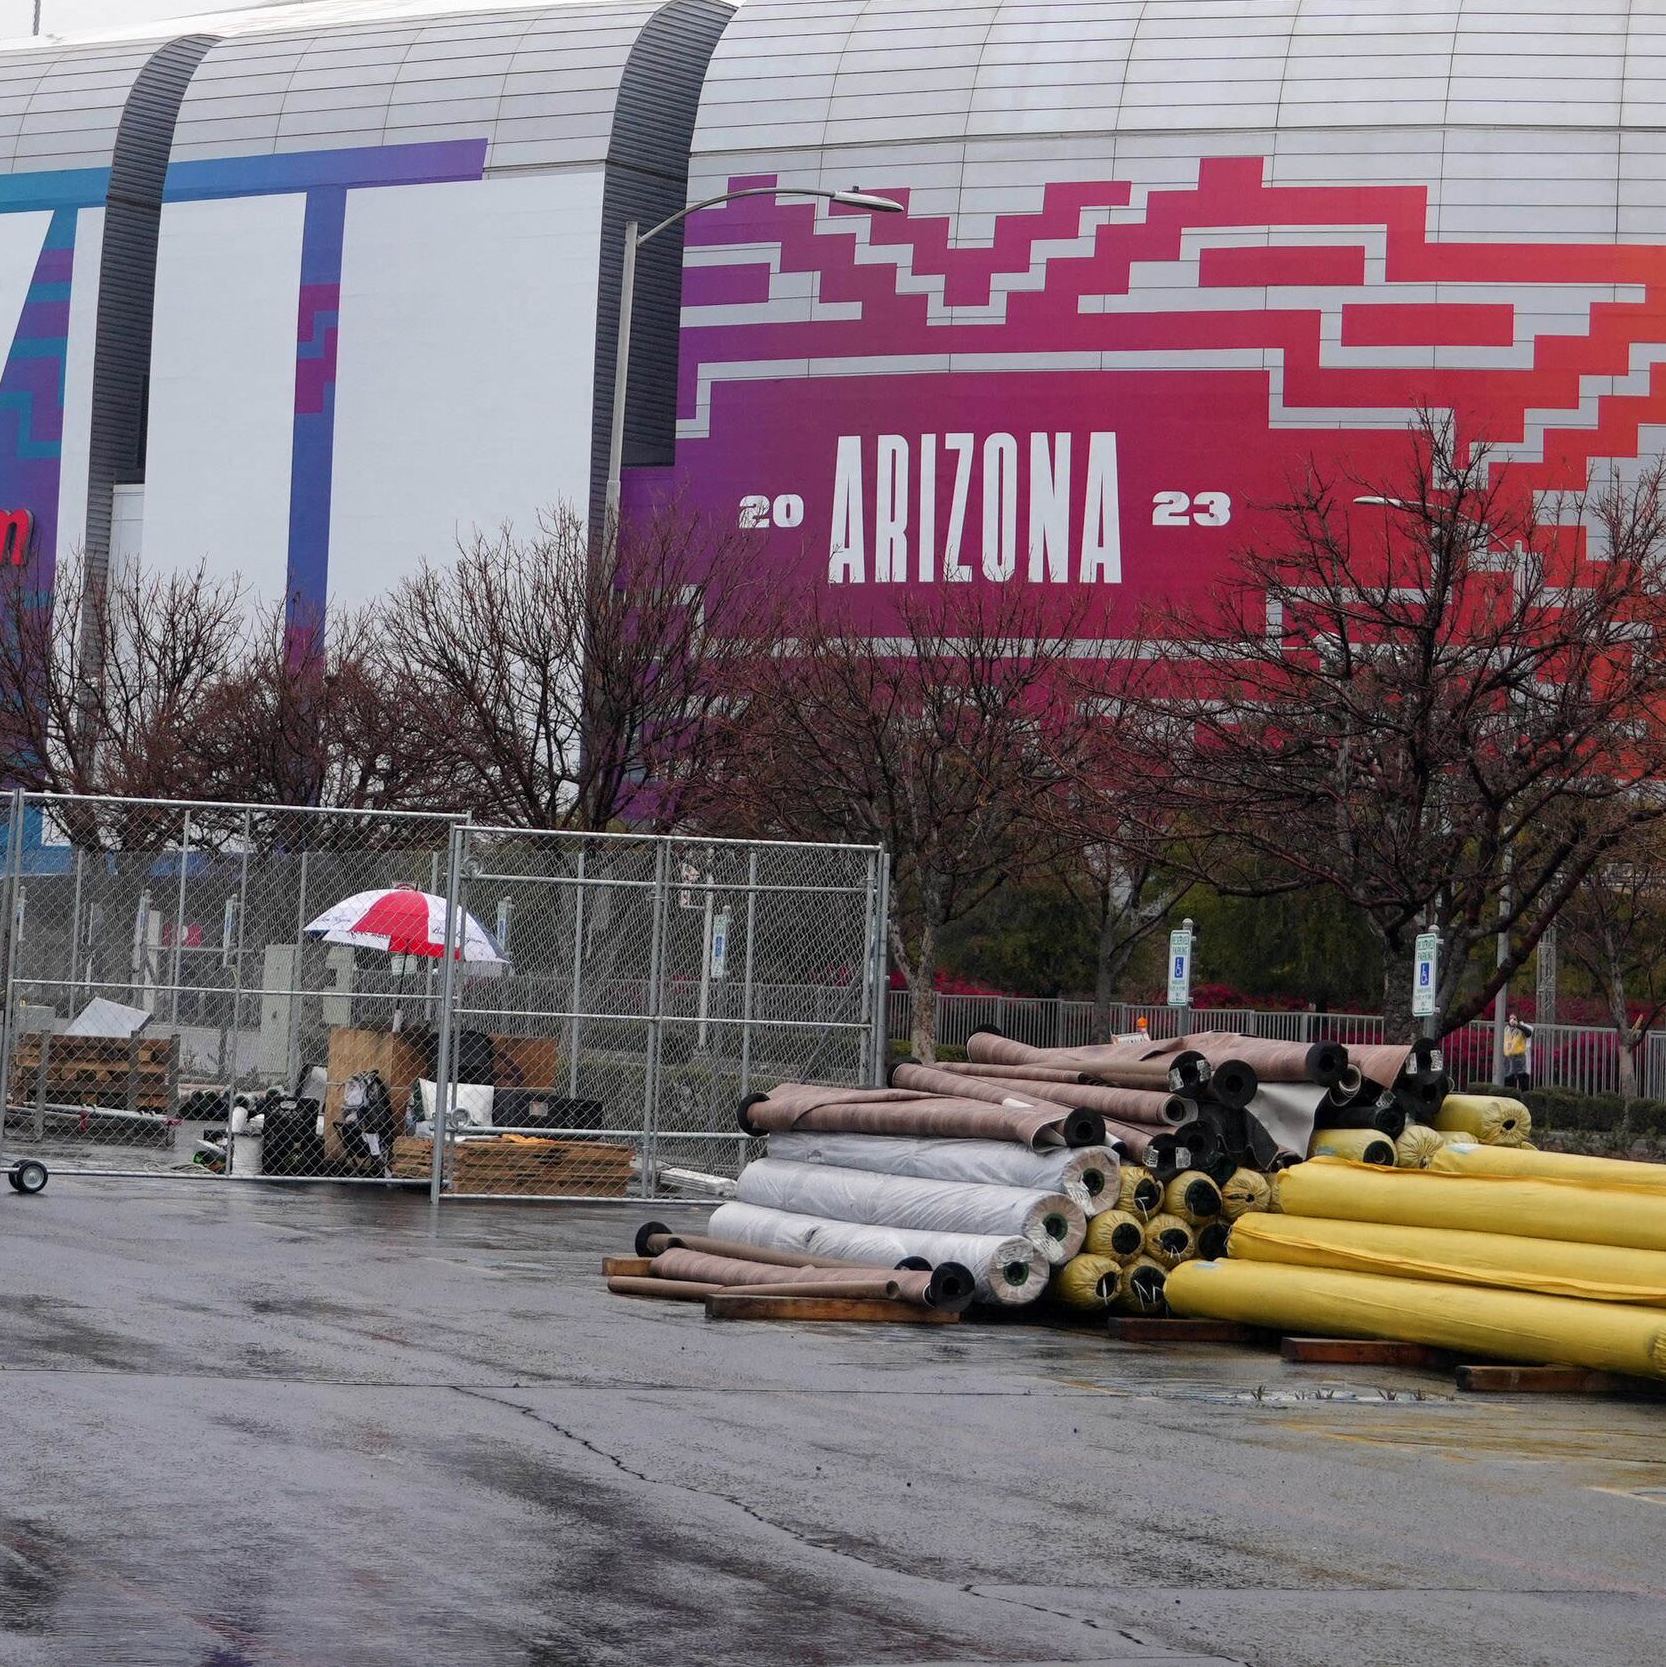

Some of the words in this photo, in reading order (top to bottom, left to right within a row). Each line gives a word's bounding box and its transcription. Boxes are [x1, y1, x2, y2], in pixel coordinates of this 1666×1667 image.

[738, 493, 805, 529] 20
[828, 431, 1123, 584] ARIZONA
[1152, 490, 1231, 527] 23
